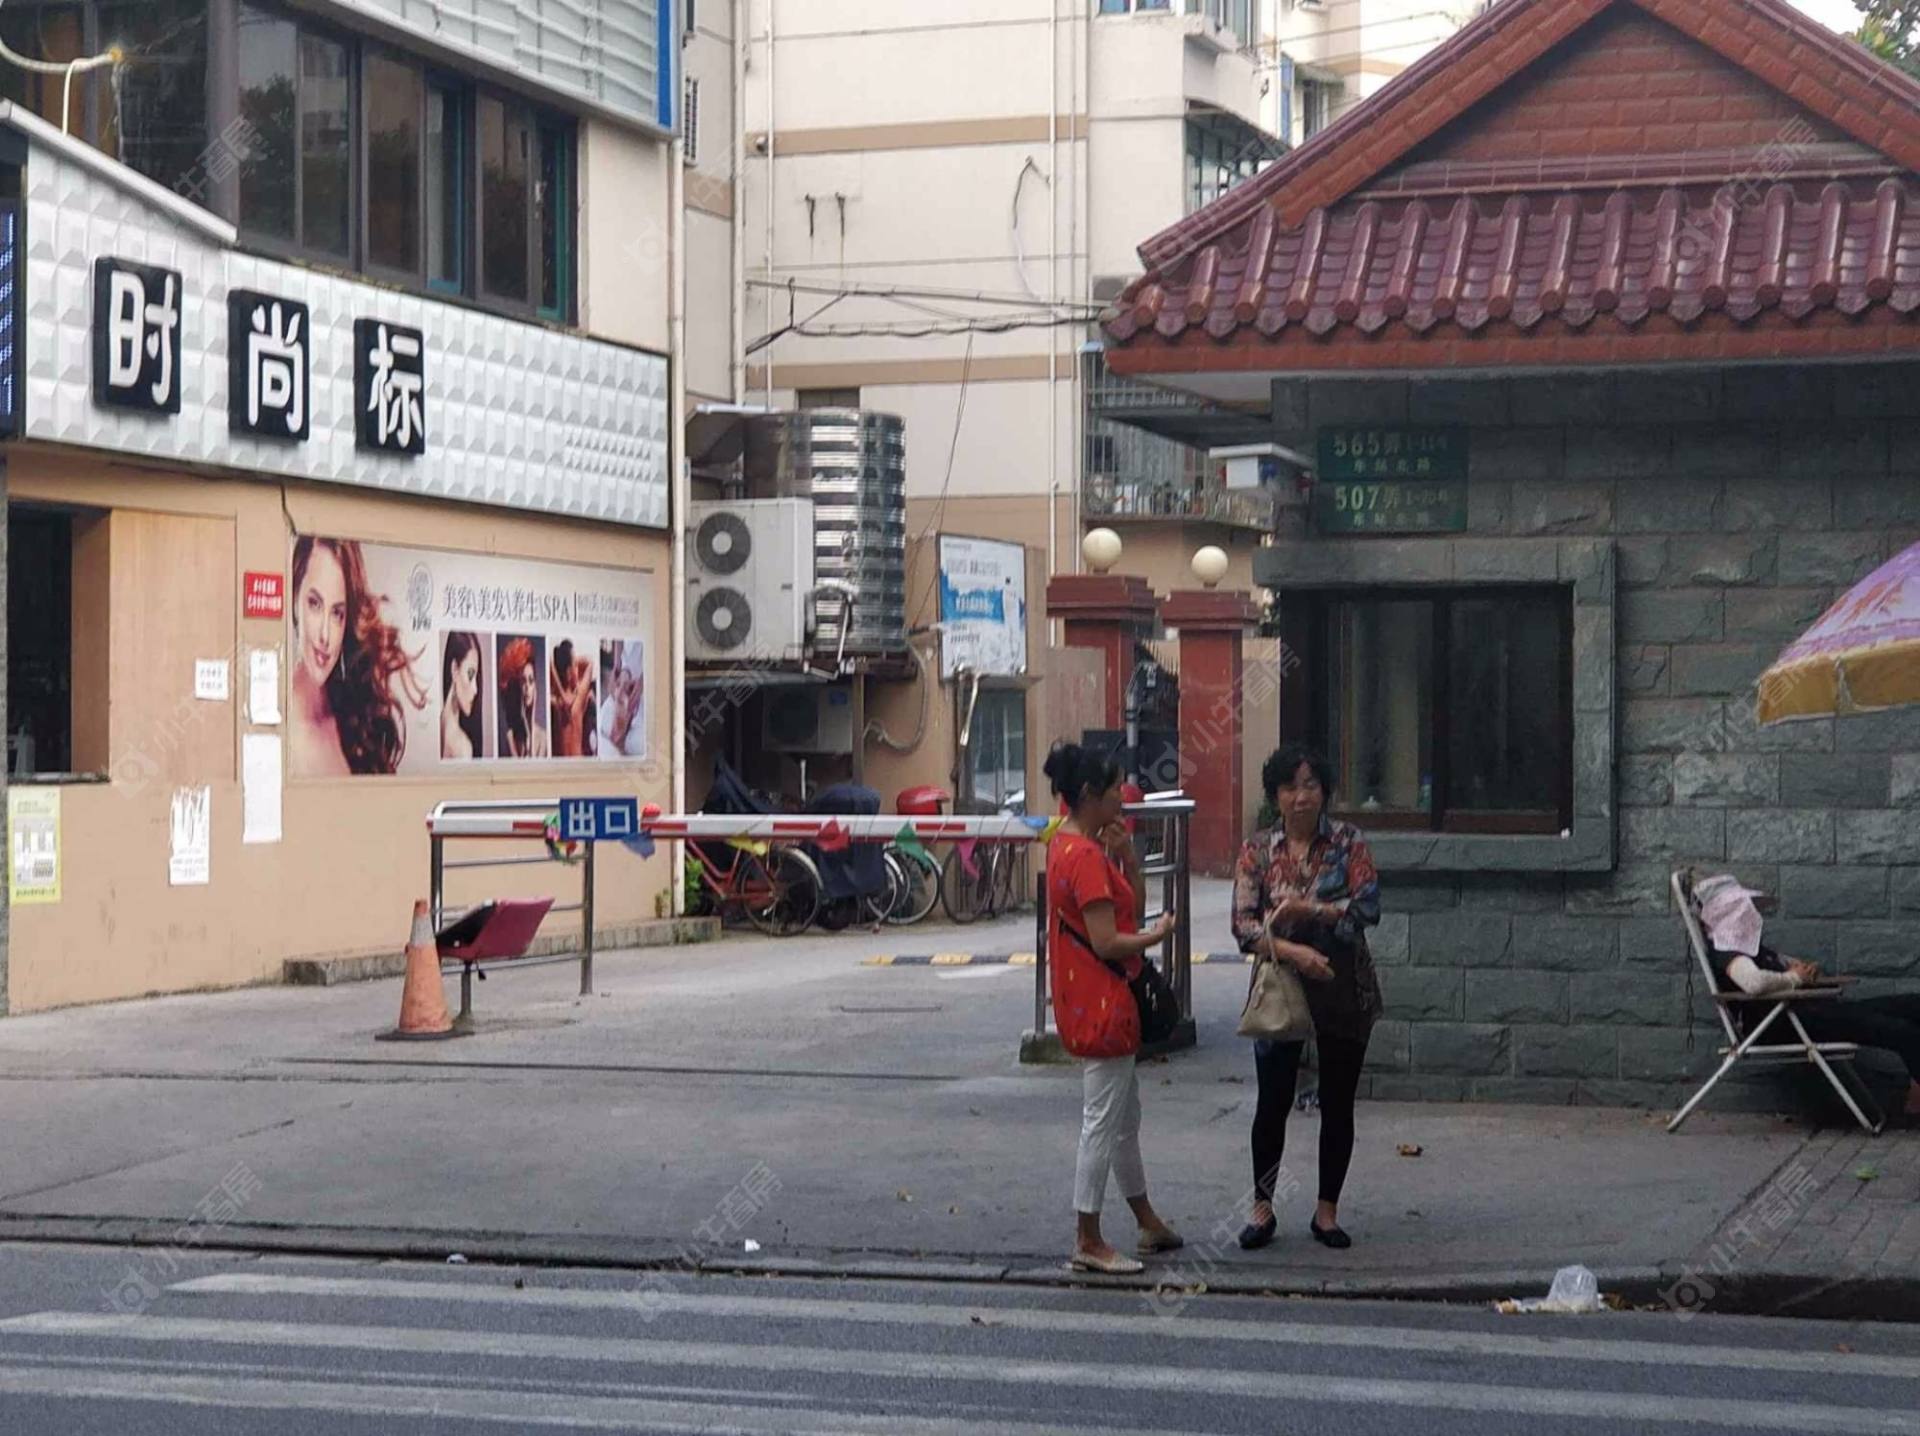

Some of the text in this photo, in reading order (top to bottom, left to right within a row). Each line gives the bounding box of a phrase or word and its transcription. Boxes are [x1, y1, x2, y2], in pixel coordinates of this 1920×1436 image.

[108, 268, 424, 449] 时尚标
[568, 800, 630, 838] 出口
